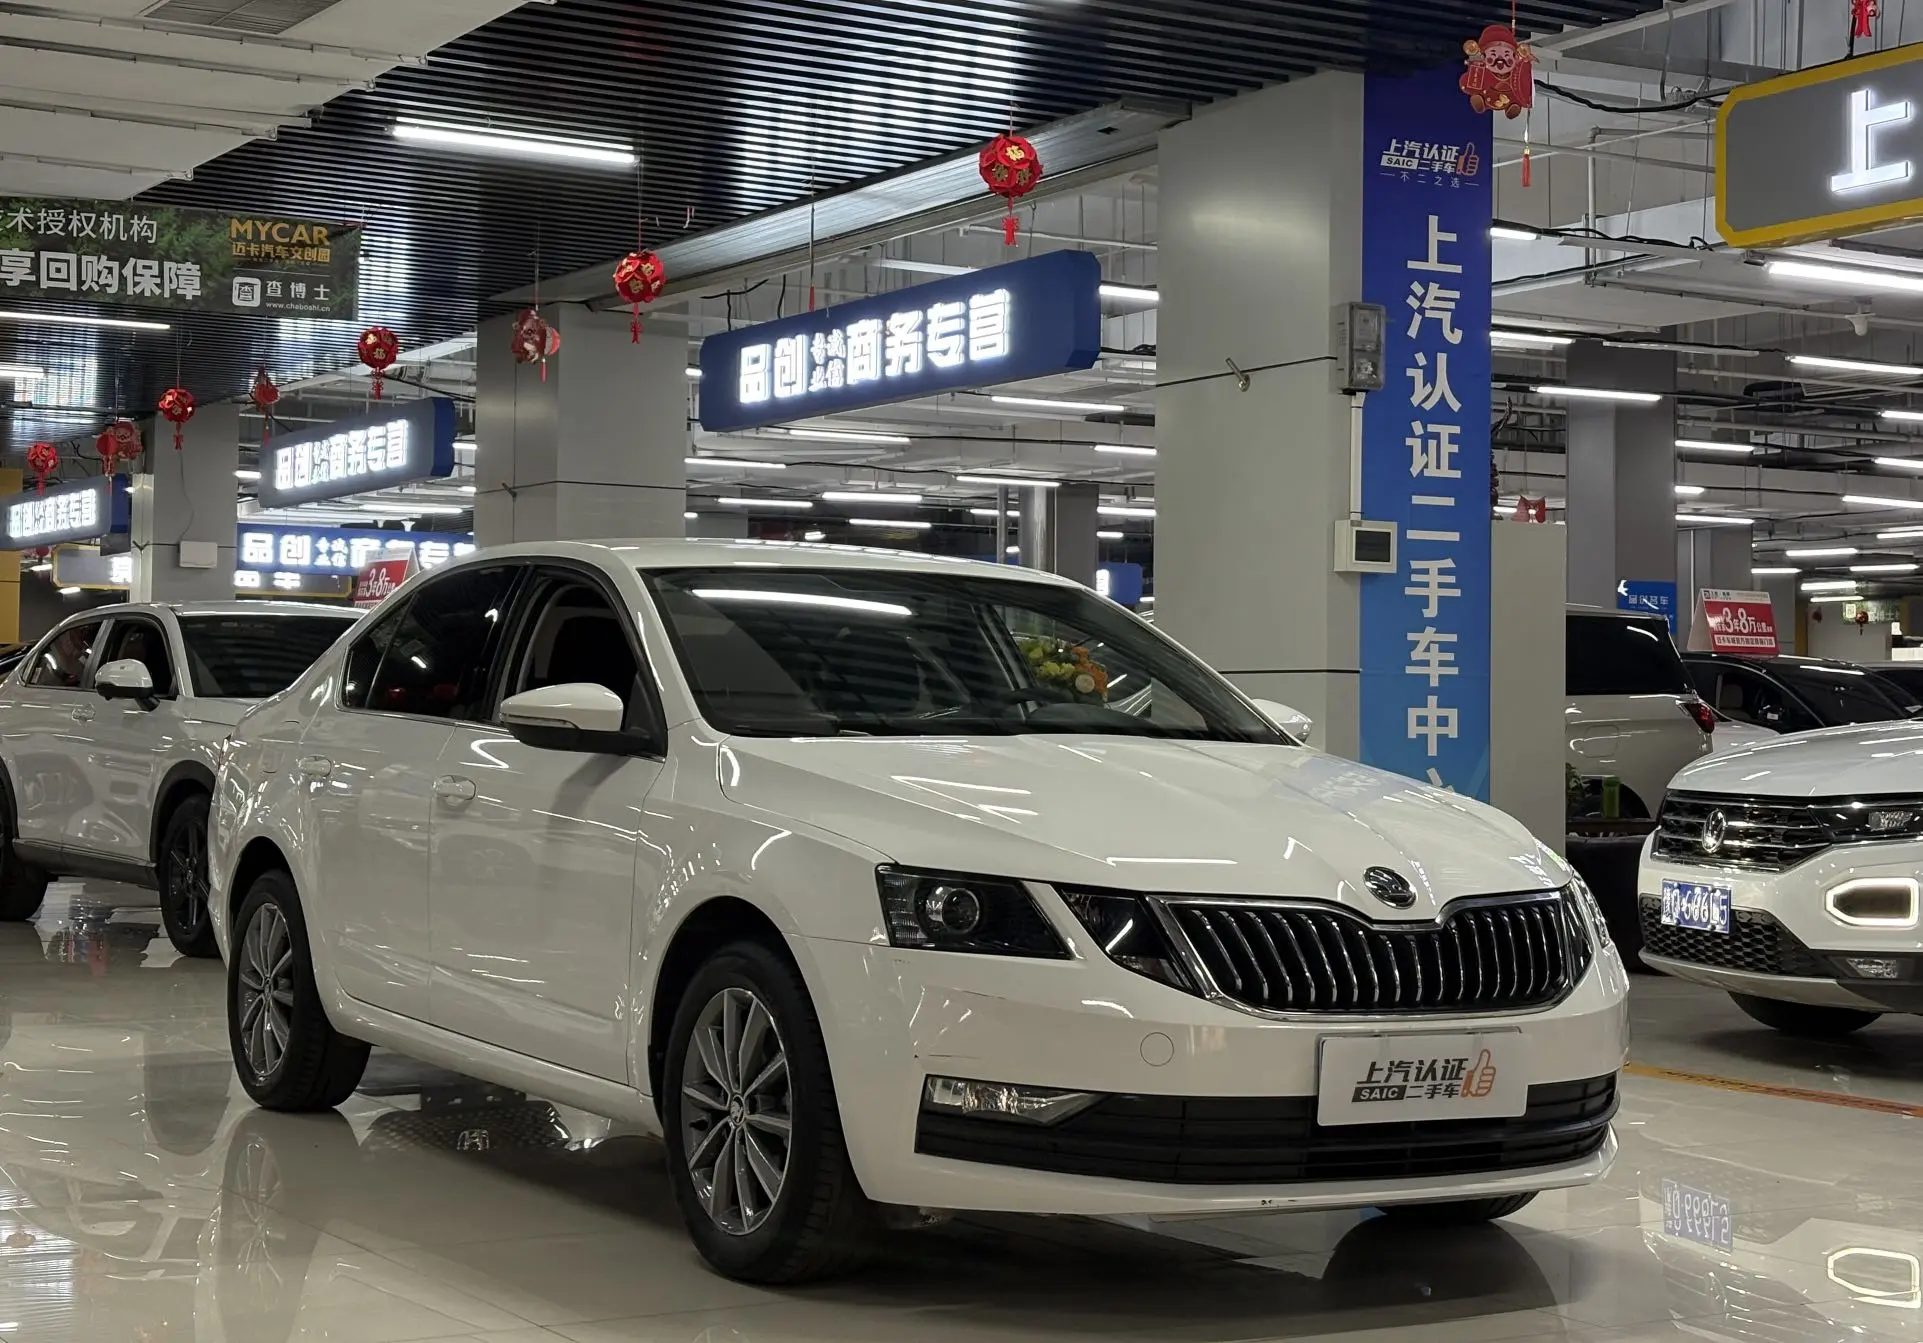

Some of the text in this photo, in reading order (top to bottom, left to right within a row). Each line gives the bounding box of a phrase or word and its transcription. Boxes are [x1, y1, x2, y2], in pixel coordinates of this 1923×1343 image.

[1382, 138, 1460, 162] 上汽认证
[1831, 89, 1910, 192] 上
[1386, 157, 1456, 174] SAIC 二手车
[1400, 171, 1460, 188] 不二之选
[0, 206, 158, 244] 术授权机构
[230, 218, 330, 245] MYCAR
[232, 242, 330, 262] 迈卡汽车文创园
[0, 248, 201, 300] 享回购保障
[266, 280, 331, 301] 查博士
[266, 302, 331, 312] www.chaboshi.cn
[1356, 1057, 1469, 1085] 上汽认证
[1360, 1083, 1461, 1100] SAIC 二手车
